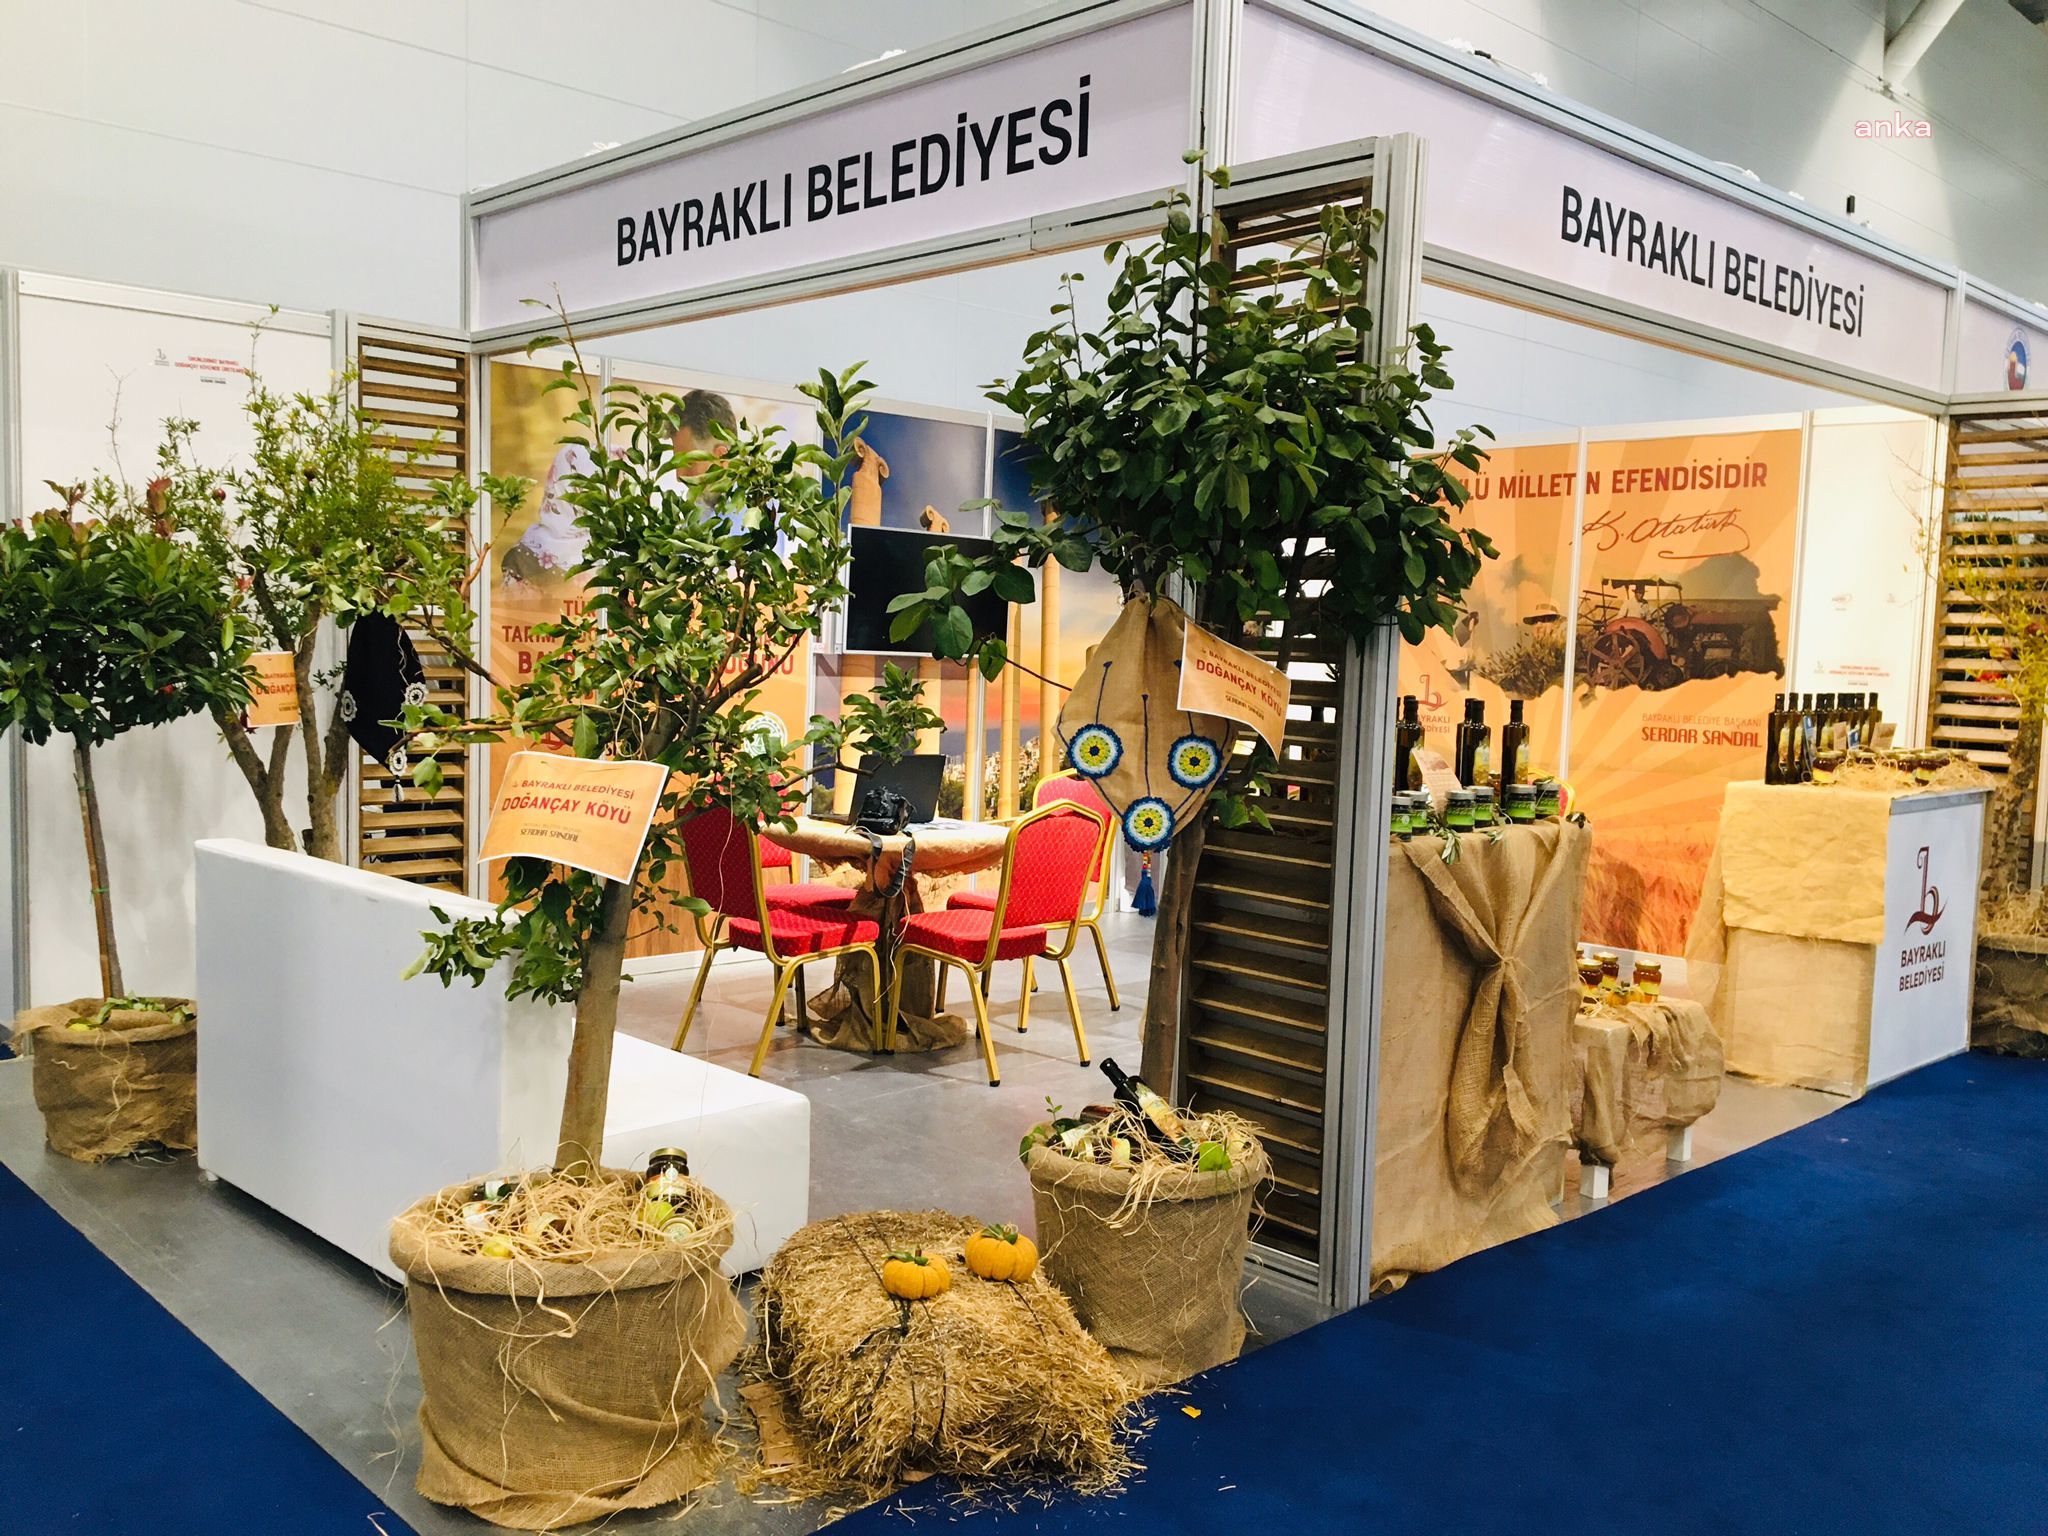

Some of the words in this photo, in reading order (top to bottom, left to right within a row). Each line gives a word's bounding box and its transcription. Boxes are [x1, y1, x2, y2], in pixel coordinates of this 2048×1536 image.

[617, 173, 792, 266] BAYRAKLI
[808, 74, 1091, 222] BELEDİYESİ
[1561, 185, 1716, 289] BAYRAKLI
[1724, 246, 1865, 338] BELEDİYESİ
[1499, 469, 1600, 499] MİLLETN
[1612, 456, 1768, 495] EFENDİSİDİR
[1196, 659, 1257, 695] DOĞANÇAY
[1641, 712, 1681, 723] BAYRAKLI
[1641, 726, 1698, 744] SERDAR
[1702, 729, 1763, 748] SANDAL
[521, 779, 572, 791] BAYRAKLI
[573, 784, 635, 800] BELEDİYESİ
[501, 791, 580, 815] DOĞANÇAY
[584, 799, 632, 824] KÖYÜ
[1900, 941, 1946, 968] BAYRAKLI
[1899, 961, 1945, 992] BELEDİYESİ
